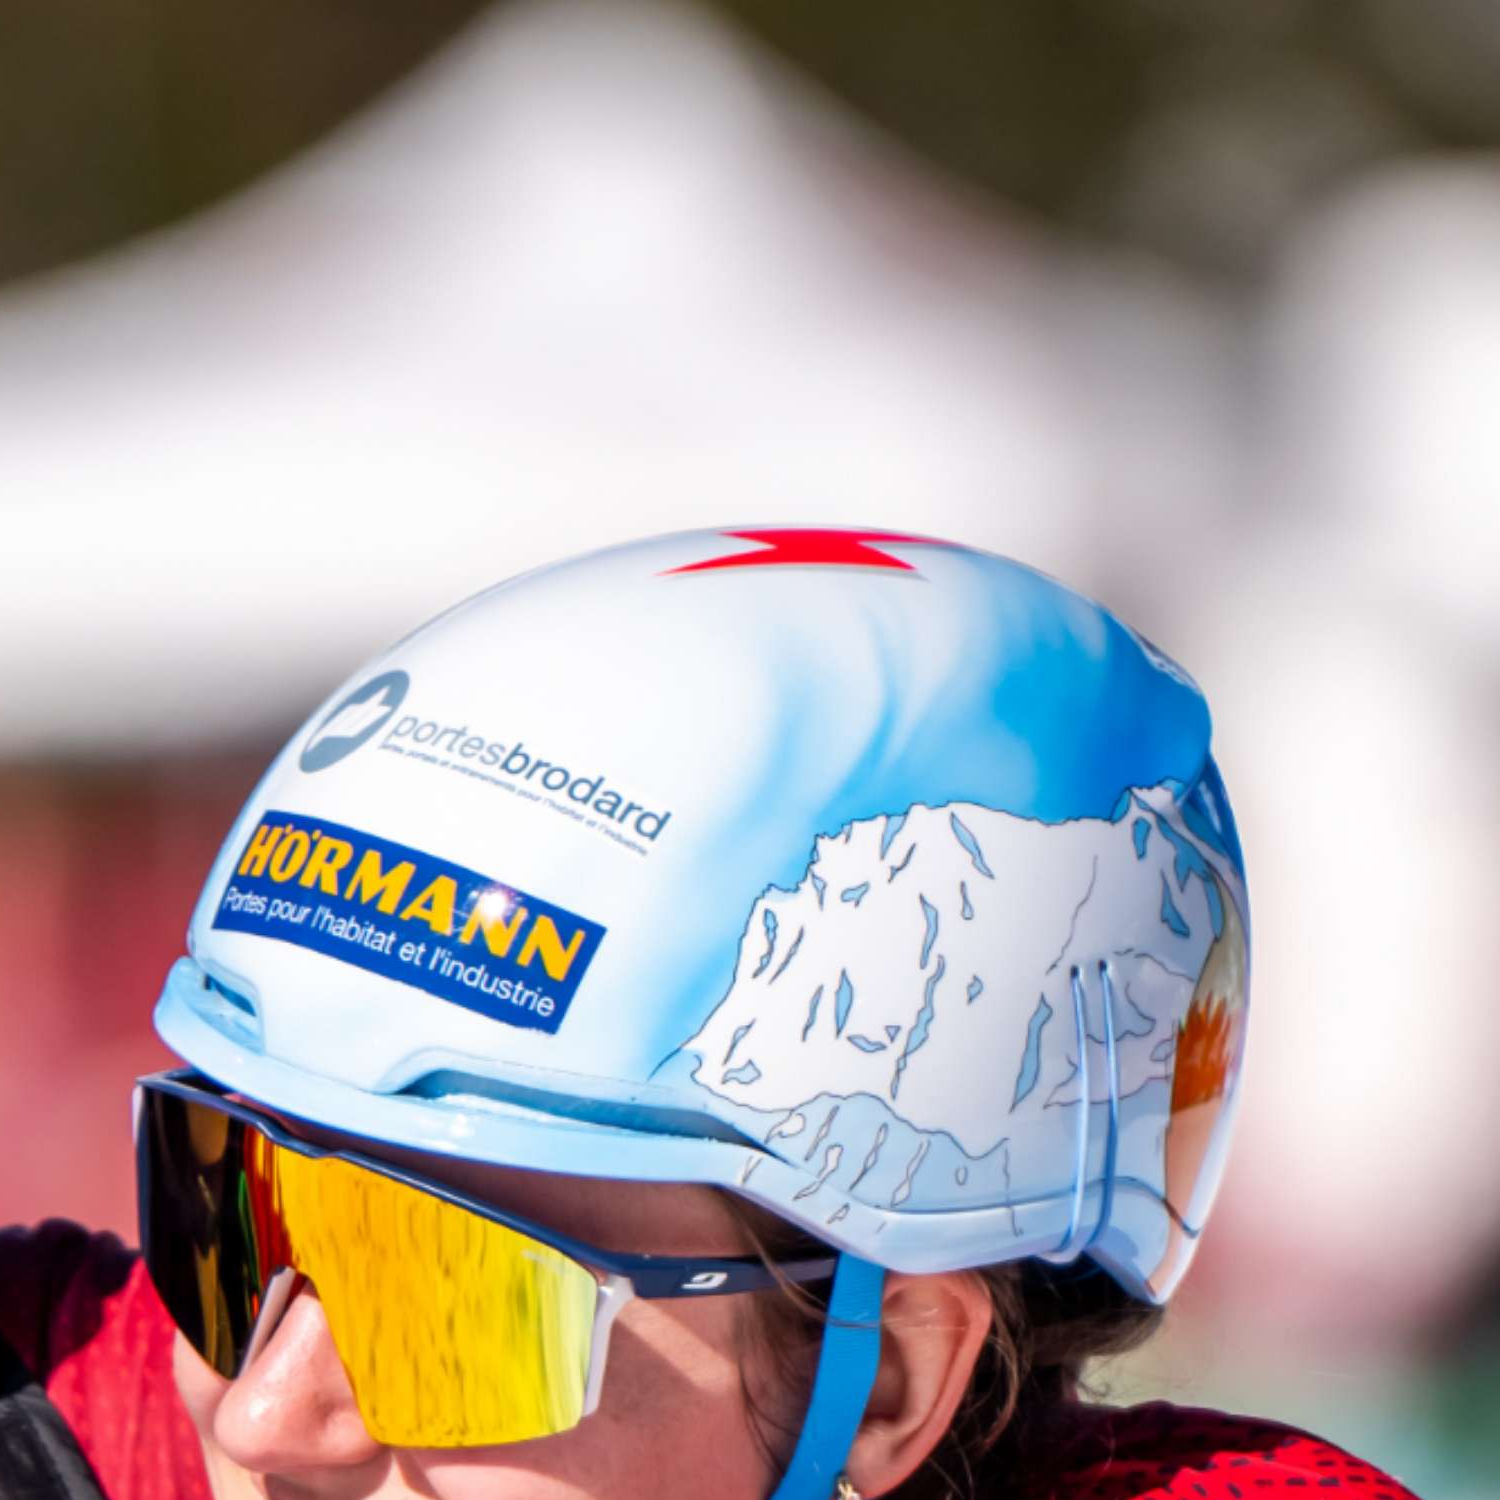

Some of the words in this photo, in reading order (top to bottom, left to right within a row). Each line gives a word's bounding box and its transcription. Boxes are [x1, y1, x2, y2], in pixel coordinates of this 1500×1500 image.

[385, 714, 672, 842] portesbrodard
[223, 884, 267, 917] Portes
[266, 897, 311, 924] pour
[310, 903, 398, 956] l'habitat
[399, 941, 428, 969] et
[429, 947, 556, 1019] l'industrie
[238, 823, 586, 982] HÖRMANN
